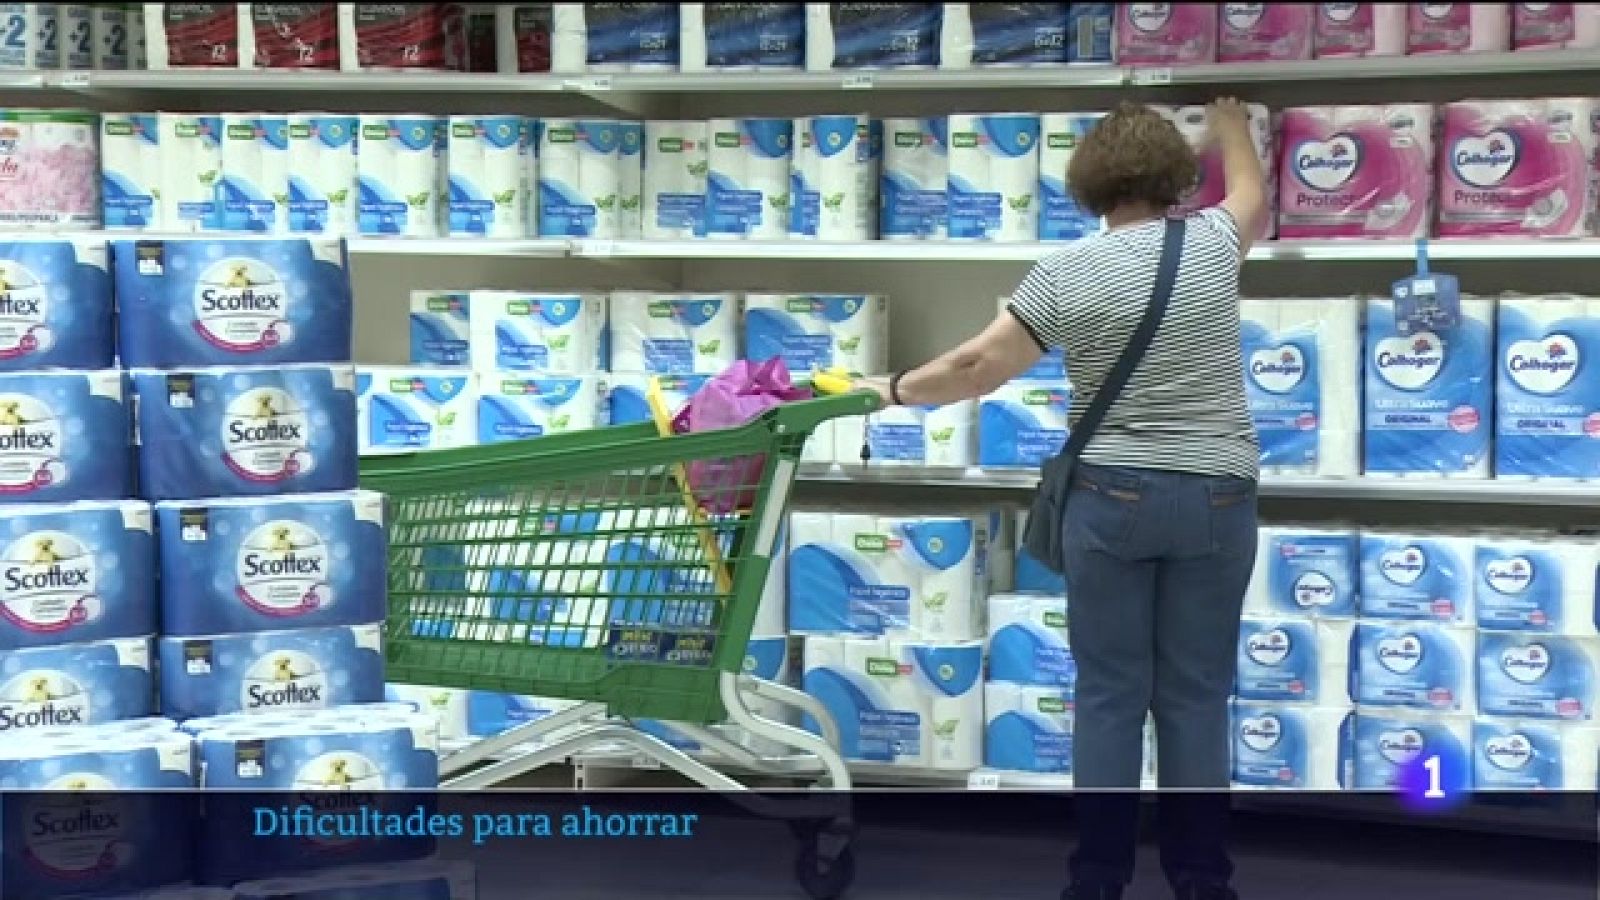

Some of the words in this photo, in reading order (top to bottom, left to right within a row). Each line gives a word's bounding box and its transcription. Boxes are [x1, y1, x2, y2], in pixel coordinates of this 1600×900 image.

[201, 289, 280, 312] Scottex
[0, 425, 54, 449] ottex
[229, 420, 301, 444] Scottex
[244, 552, 321, 577] Scottex
[4, 563, 88, 592] Scottex
[248, 682, 321, 707] Scottex
[33, 807, 119, 835] Scottex
